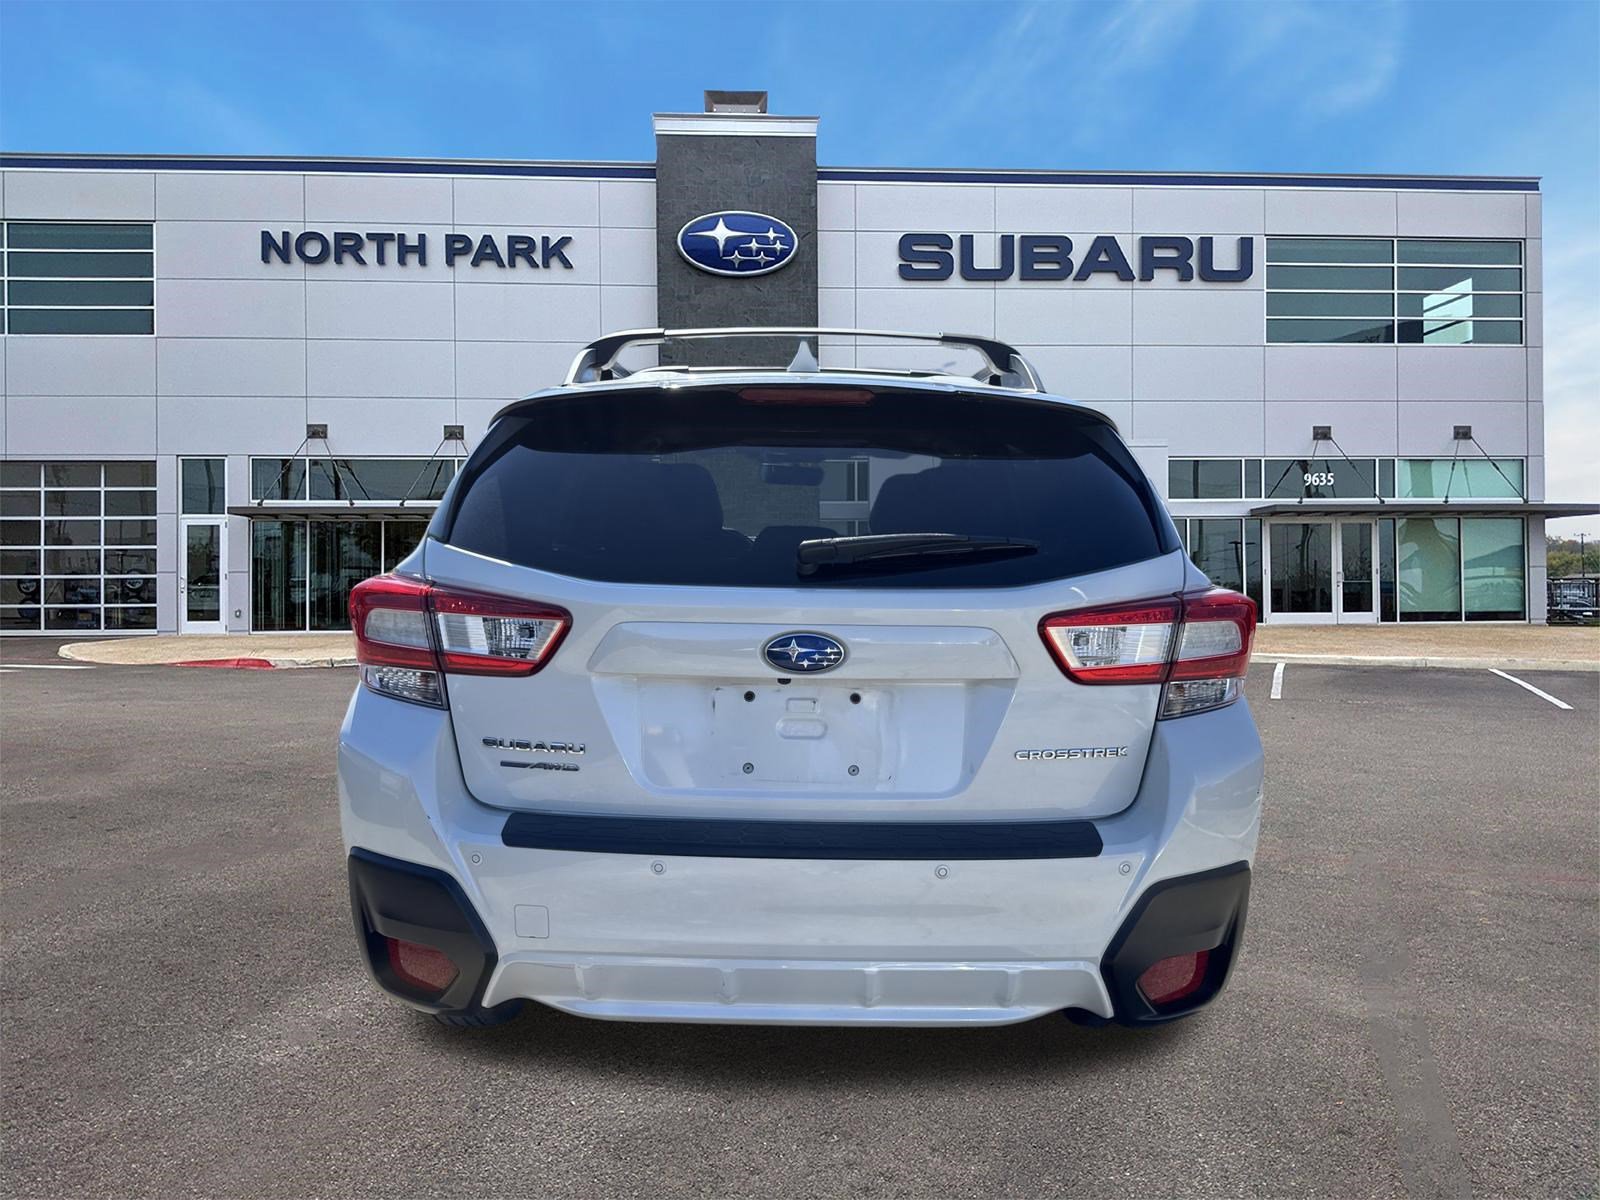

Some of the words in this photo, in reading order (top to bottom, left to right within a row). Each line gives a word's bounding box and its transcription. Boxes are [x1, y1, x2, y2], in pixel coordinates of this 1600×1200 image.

[260, 230, 427, 266] NORTH
[445, 233, 574, 269] PARK
[898, 232, 1254, 282] SUBARU
[1303, 472, 1335, 486] 9635
[482, 736, 586, 755] SUBARU
[1015, 746, 1128, 760] CROSSTREK
